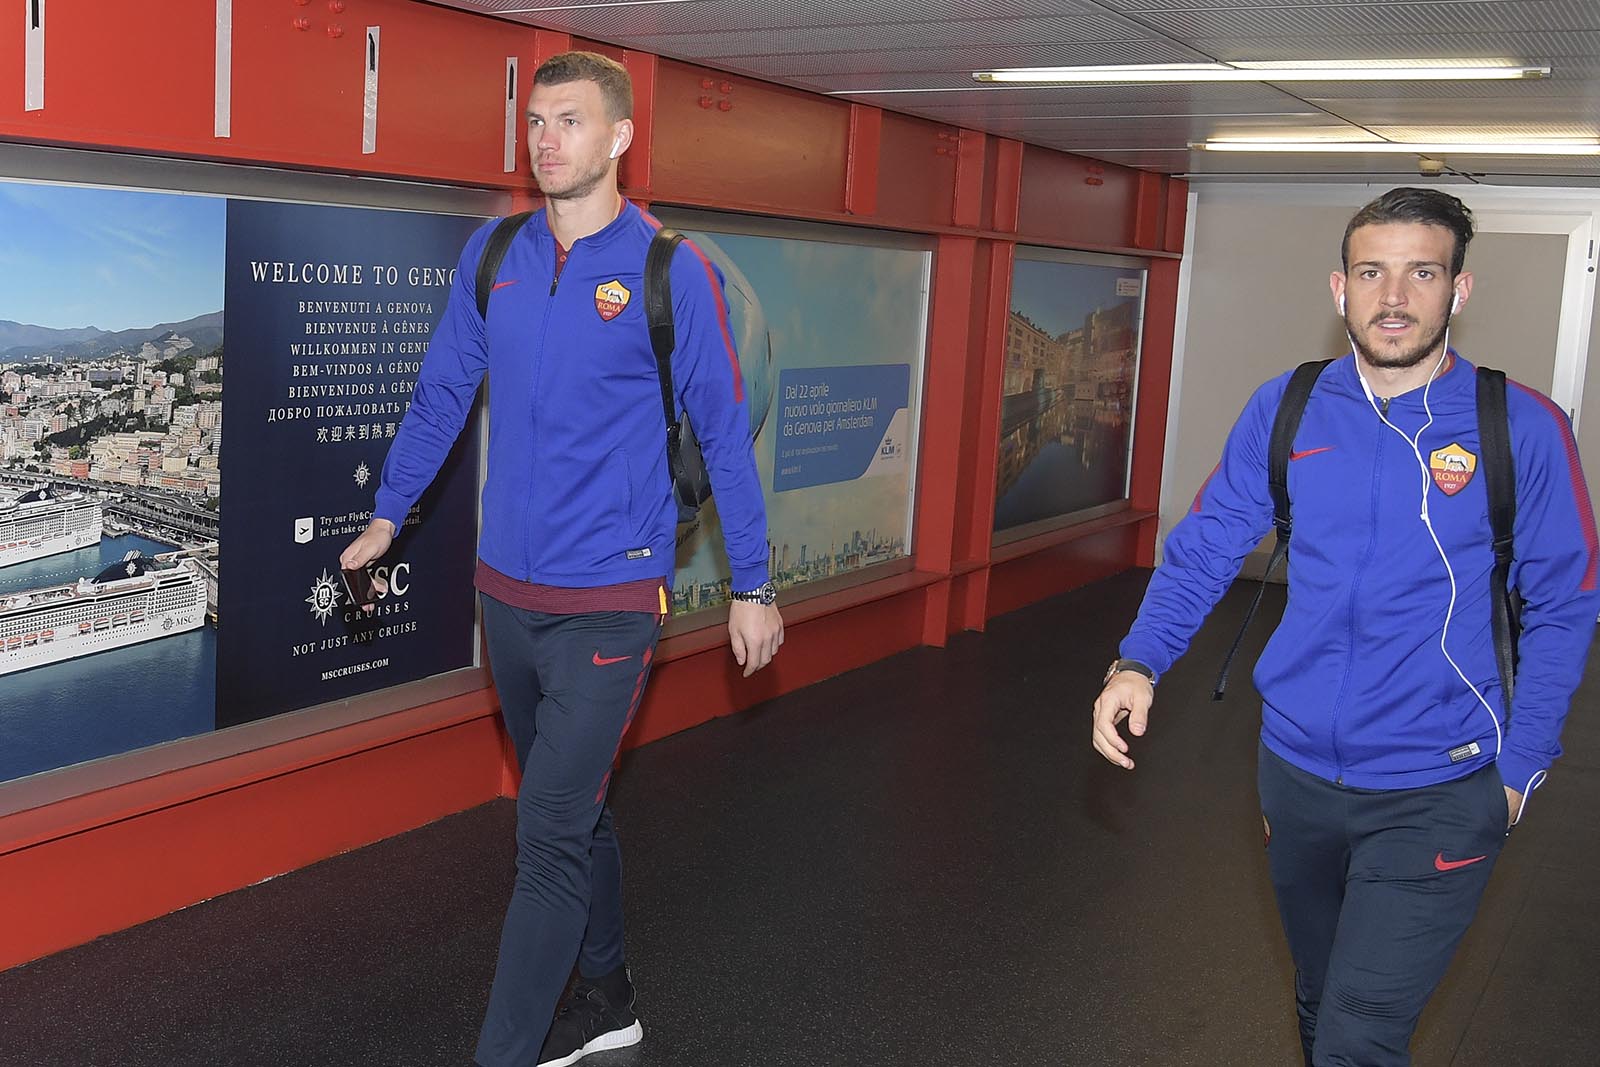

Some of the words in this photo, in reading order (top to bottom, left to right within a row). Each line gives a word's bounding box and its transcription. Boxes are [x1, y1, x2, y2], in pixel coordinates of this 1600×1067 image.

[250, 261, 363, 285] WELCOME
[373, 266, 399, 286] TO
[298, 301, 371, 314] BENVENUTI
[375, 302, 383, 314] A
[387, 302, 433, 314] GENOVA
[597, 301, 620, 312] ROMA
[305, 322, 377, 334] BIENVENUE
[382, 319, 389, 334] À
[393, 320, 430, 334] GÊNES
[290, 342, 377, 356] WILLKOMMEN
[382, 342, 395, 354] IN
[399, 342, 430, 354] GENU
[292, 363, 372, 377] BEM-VINDOS
[376, 362, 384, 374] A
[388, 360, 423, 374] GÉNO
[288, 383, 375, 399] BIENVENIDOS
[379, 382, 386, 394] A
[391, 380, 418, 394] GÉN
[785, 384, 798, 400] Dal
[799, 385, 808, 399] 22
[809, 383, 829, 400] aprile
[267, 406, 311, 422] ДОБРО
[316, 401, 400, 418] ПОЖАЛОВАТЬ
[784, 404, 808, 418] nuovo
[809, 401, 825, 416] volo
[825, 398, 862, 416] giornaliero
[863, 397, 878, 411] KLM
[316, 422, 403, 443] 欢迎来到热那
[783, 421, 793, 437] da
[794, 421, 822, 435] Genova
[823, 419, 835, 435] per
[836, 415, 873, 430] Amsterdam
[880, 446, 895, 455] KLM
[1434, 472, 1467, 483] ROMA
[320, 515, 333, 526] Try
[334, 515, 347, 524] our
[320, 528, 330, 537] let
[331, 528, 340, 536] us
[341, 524, 356, 535] take
[357, 524, 369, 533] car
[176, 615, 194, 626] MSC
[344, 601, 409, 623] CRUISES
[292, 642, 316, 656] NOT
[320, 635, 348, 650] JUST
[352, 630, 374, 644] ANY
[378, 621, 417, 638] CRUISE
[321, 658, 389, 681] MSCCRUISES.COM
